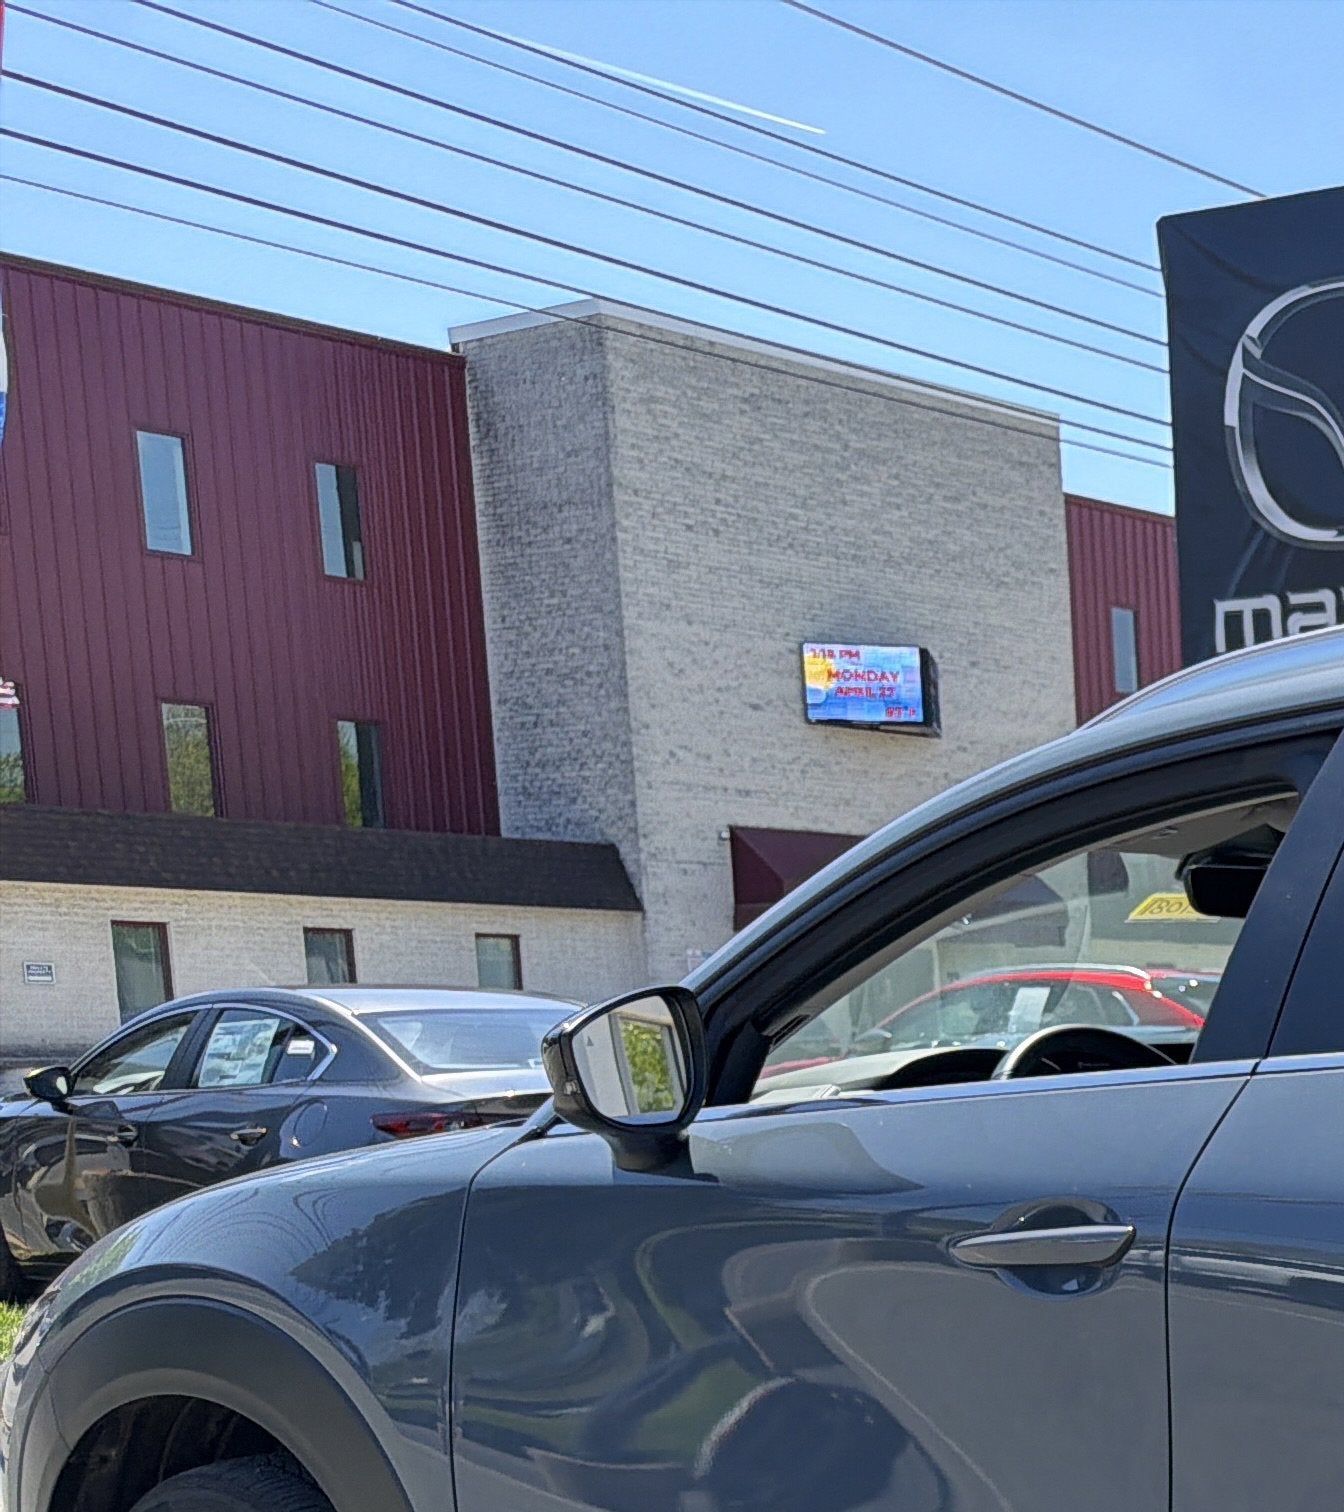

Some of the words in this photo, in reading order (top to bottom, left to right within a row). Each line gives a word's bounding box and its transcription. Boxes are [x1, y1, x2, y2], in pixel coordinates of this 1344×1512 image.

[839, 649, 861, 660] PM
[827, 668, 900, 682] MONDAY
[835, 686, 876, 698] APRIL
